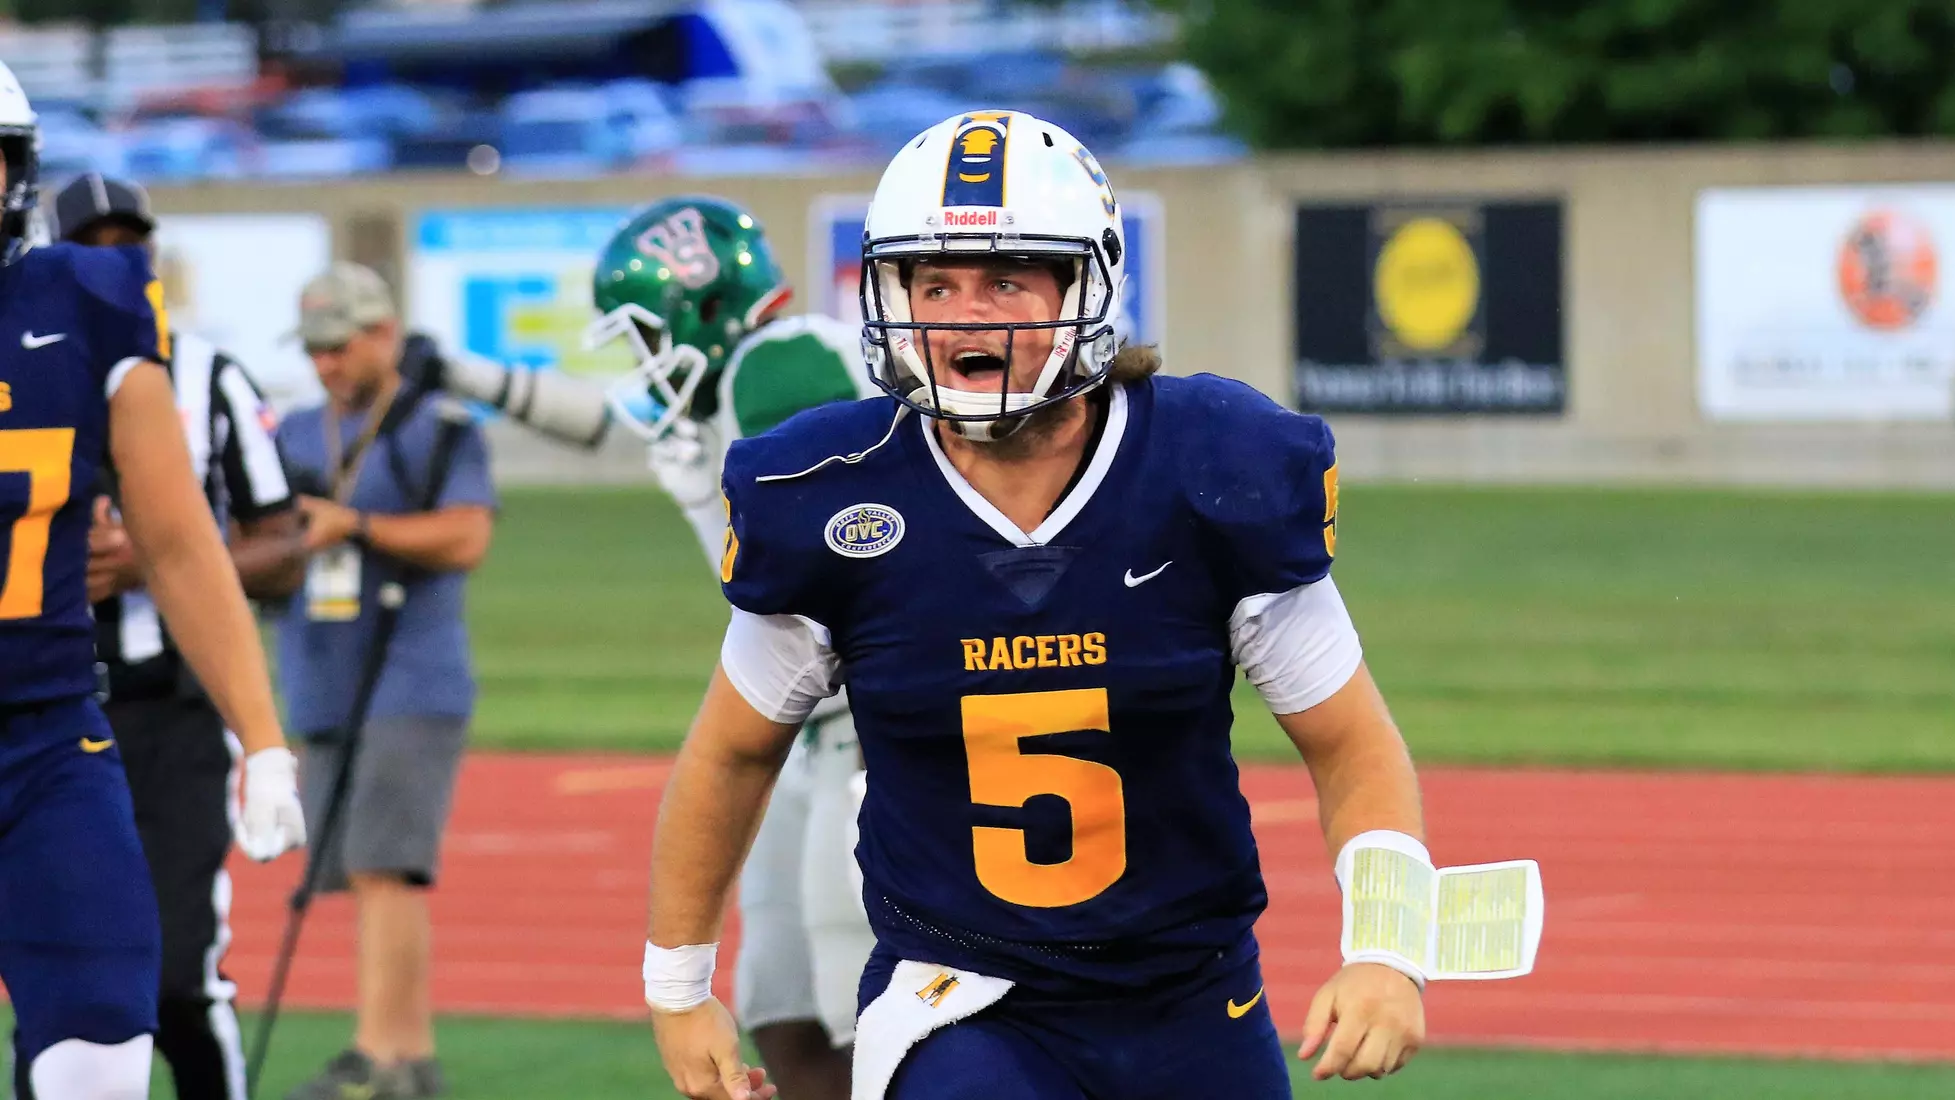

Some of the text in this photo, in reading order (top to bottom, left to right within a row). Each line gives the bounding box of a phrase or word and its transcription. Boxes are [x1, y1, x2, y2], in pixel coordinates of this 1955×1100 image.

[944, 210, 997, 226] Riddell
[837, 510, 895, 527] OHIO VALLEY
[846, 520, 883, 542] OVC
[842, 538, 891, 551] CONFERENCE
[960, 632, 1107, 671] RACERS
[960, 688, 1126, 907] 5
